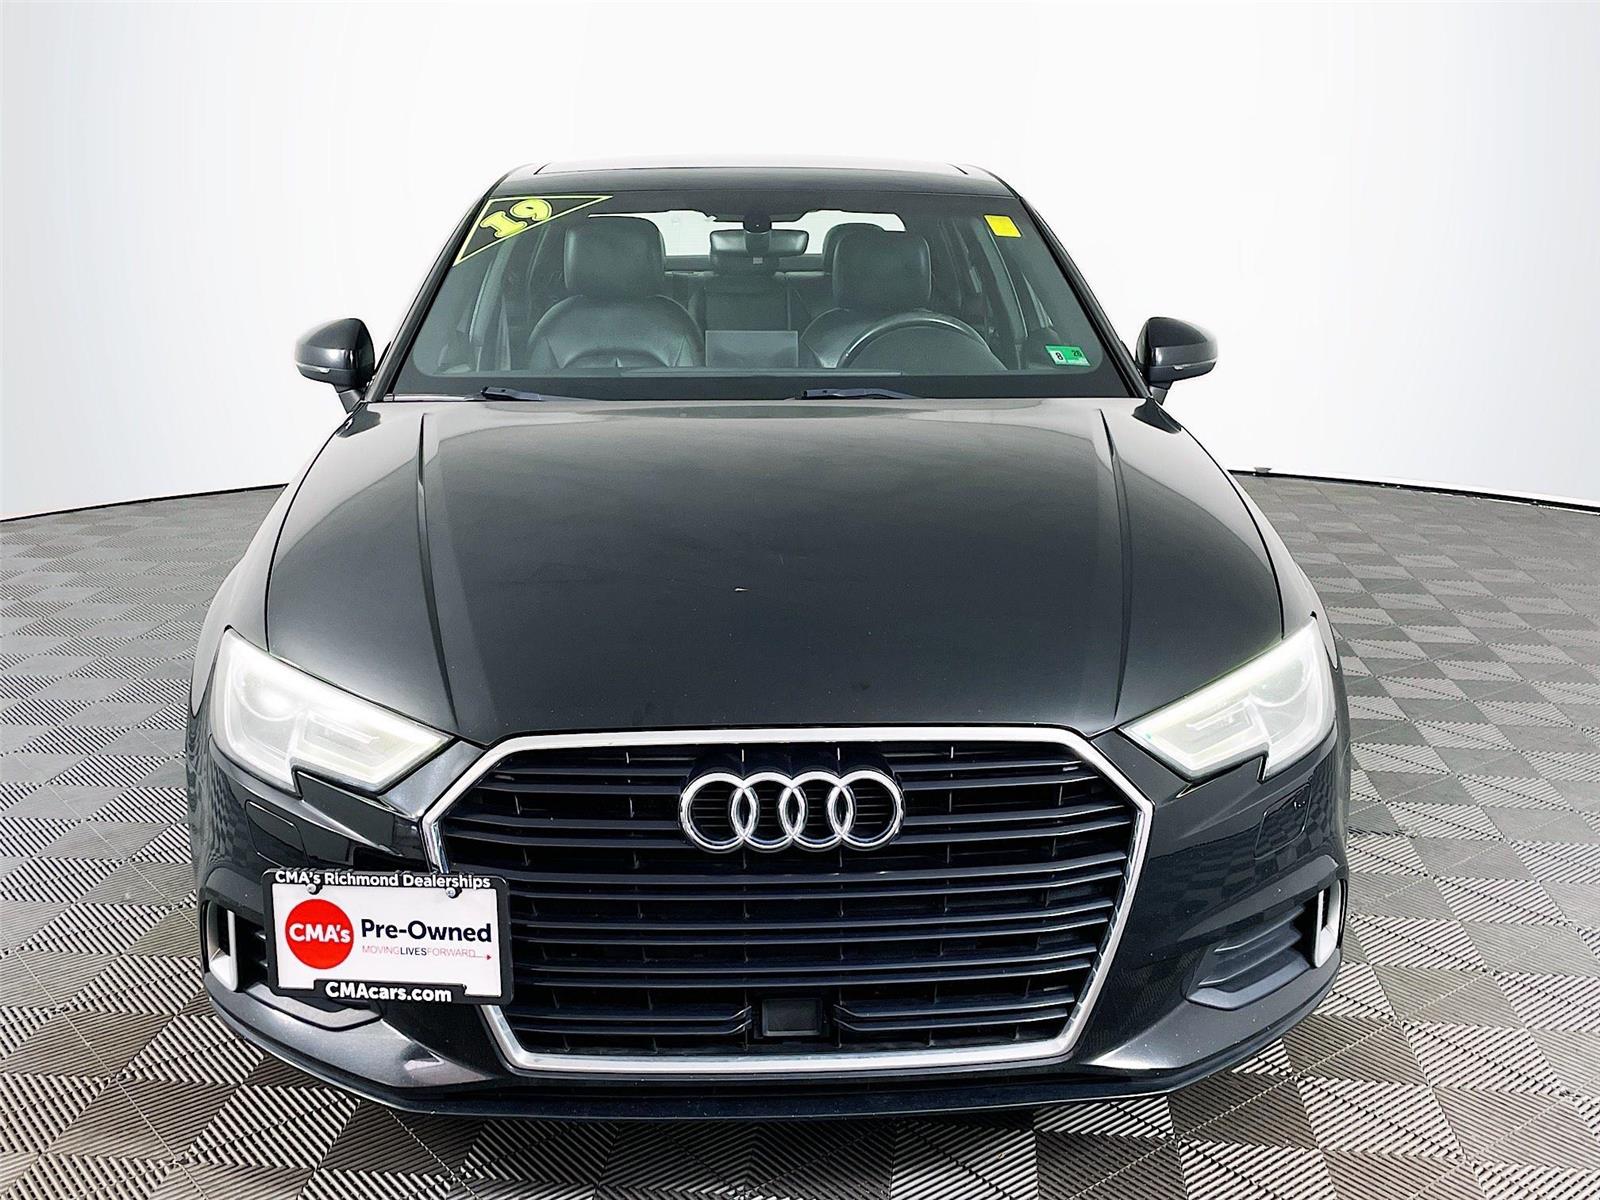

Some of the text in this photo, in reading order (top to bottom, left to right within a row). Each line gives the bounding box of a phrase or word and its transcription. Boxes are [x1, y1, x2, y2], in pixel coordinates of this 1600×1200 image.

[480, 198, 553, 238] 19
[1055, 352, 1064, 361] 8
[274, 871, 491, 890] CMA's Richmond Dealerships
[288, 922, 351, 944] CMA's
[361, 918, 492, 943] Pre-Owned
[325, 982, 452, 1002] CMAcars.com
